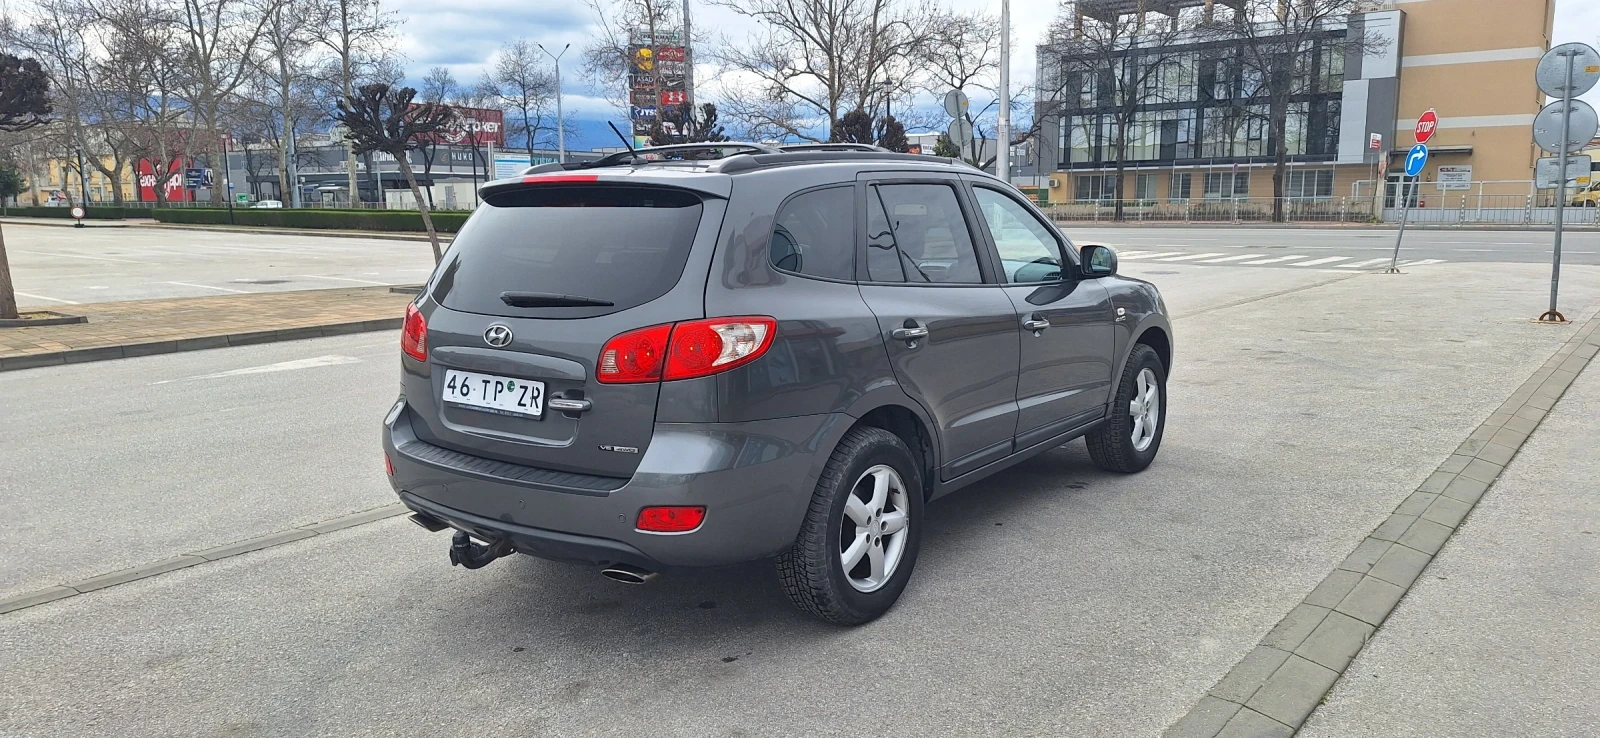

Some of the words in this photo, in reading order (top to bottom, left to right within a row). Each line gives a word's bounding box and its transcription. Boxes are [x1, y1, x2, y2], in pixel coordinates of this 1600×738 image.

[1416, 121, 1435, 133] STOP
[447, 374, 470, 397] 46
[482, 379, 504, 402] TP
[517, 385, 541, 409] ZR
